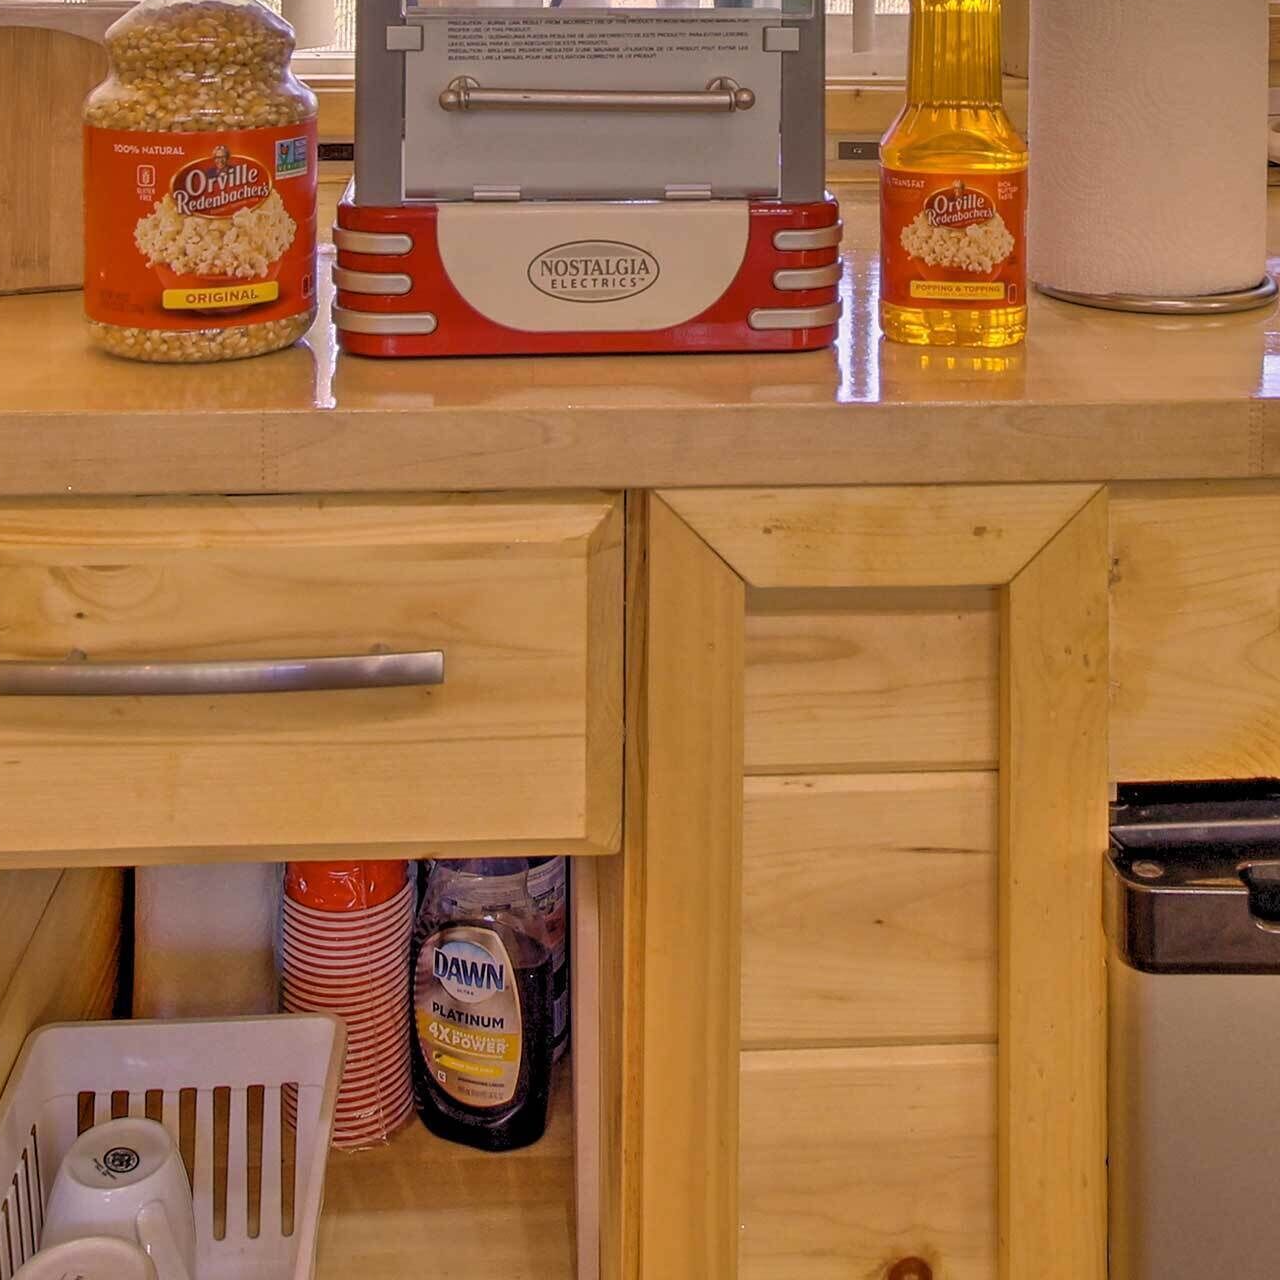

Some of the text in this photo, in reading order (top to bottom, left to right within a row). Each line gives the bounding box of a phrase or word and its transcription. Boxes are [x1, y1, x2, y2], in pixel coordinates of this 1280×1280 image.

[113, 144, 185, 155] 100% NATURAL
[184, 163, 259, 197] Orville
[173, 182, 269, 216] Redenbacher's
[933, 193, 985, 215] Orville
[925, 207, 994, 226] Redenbacher's
[540, 258, 650, 276] NOSTALGIA
[551, 277, 637, 289] ELECTRICS
[916, 283, 953, 292] POPPING
[185, 288, 259, 304] ORIGINAL
[434, 949, 505, 991] DAWN
[432, 1001, 504, 1029] PLATINUM
[428, 1021, 451, 1045] 4X
[452, 1033, 506, 1054] POWER
